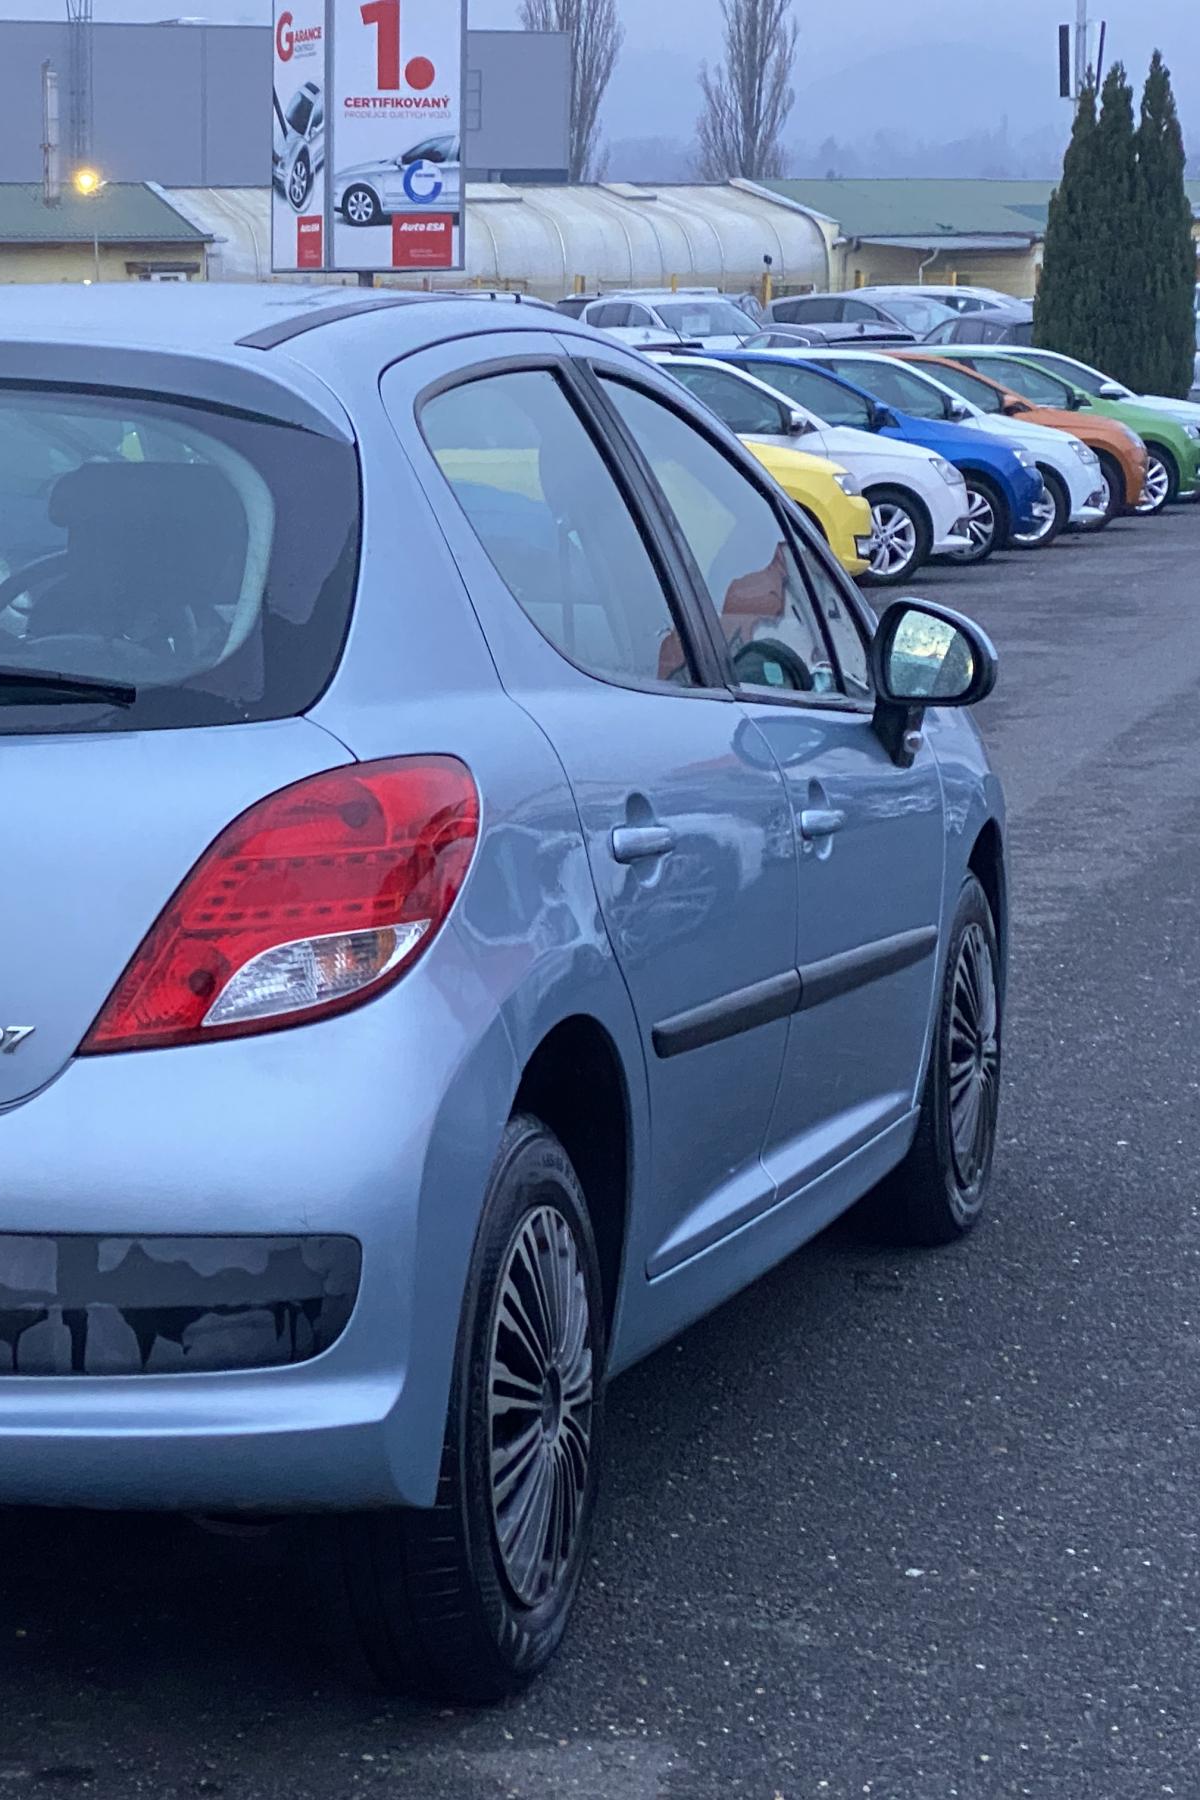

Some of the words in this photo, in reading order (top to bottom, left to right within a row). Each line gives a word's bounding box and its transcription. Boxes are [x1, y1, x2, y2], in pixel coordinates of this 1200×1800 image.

[360, 0, 435, 90] 1.
[344, 95, 449, 109] CERTIFIKOVANÝ
[400, 222, 426, 231] Auto
[426, 222, 445, 231] ESA
